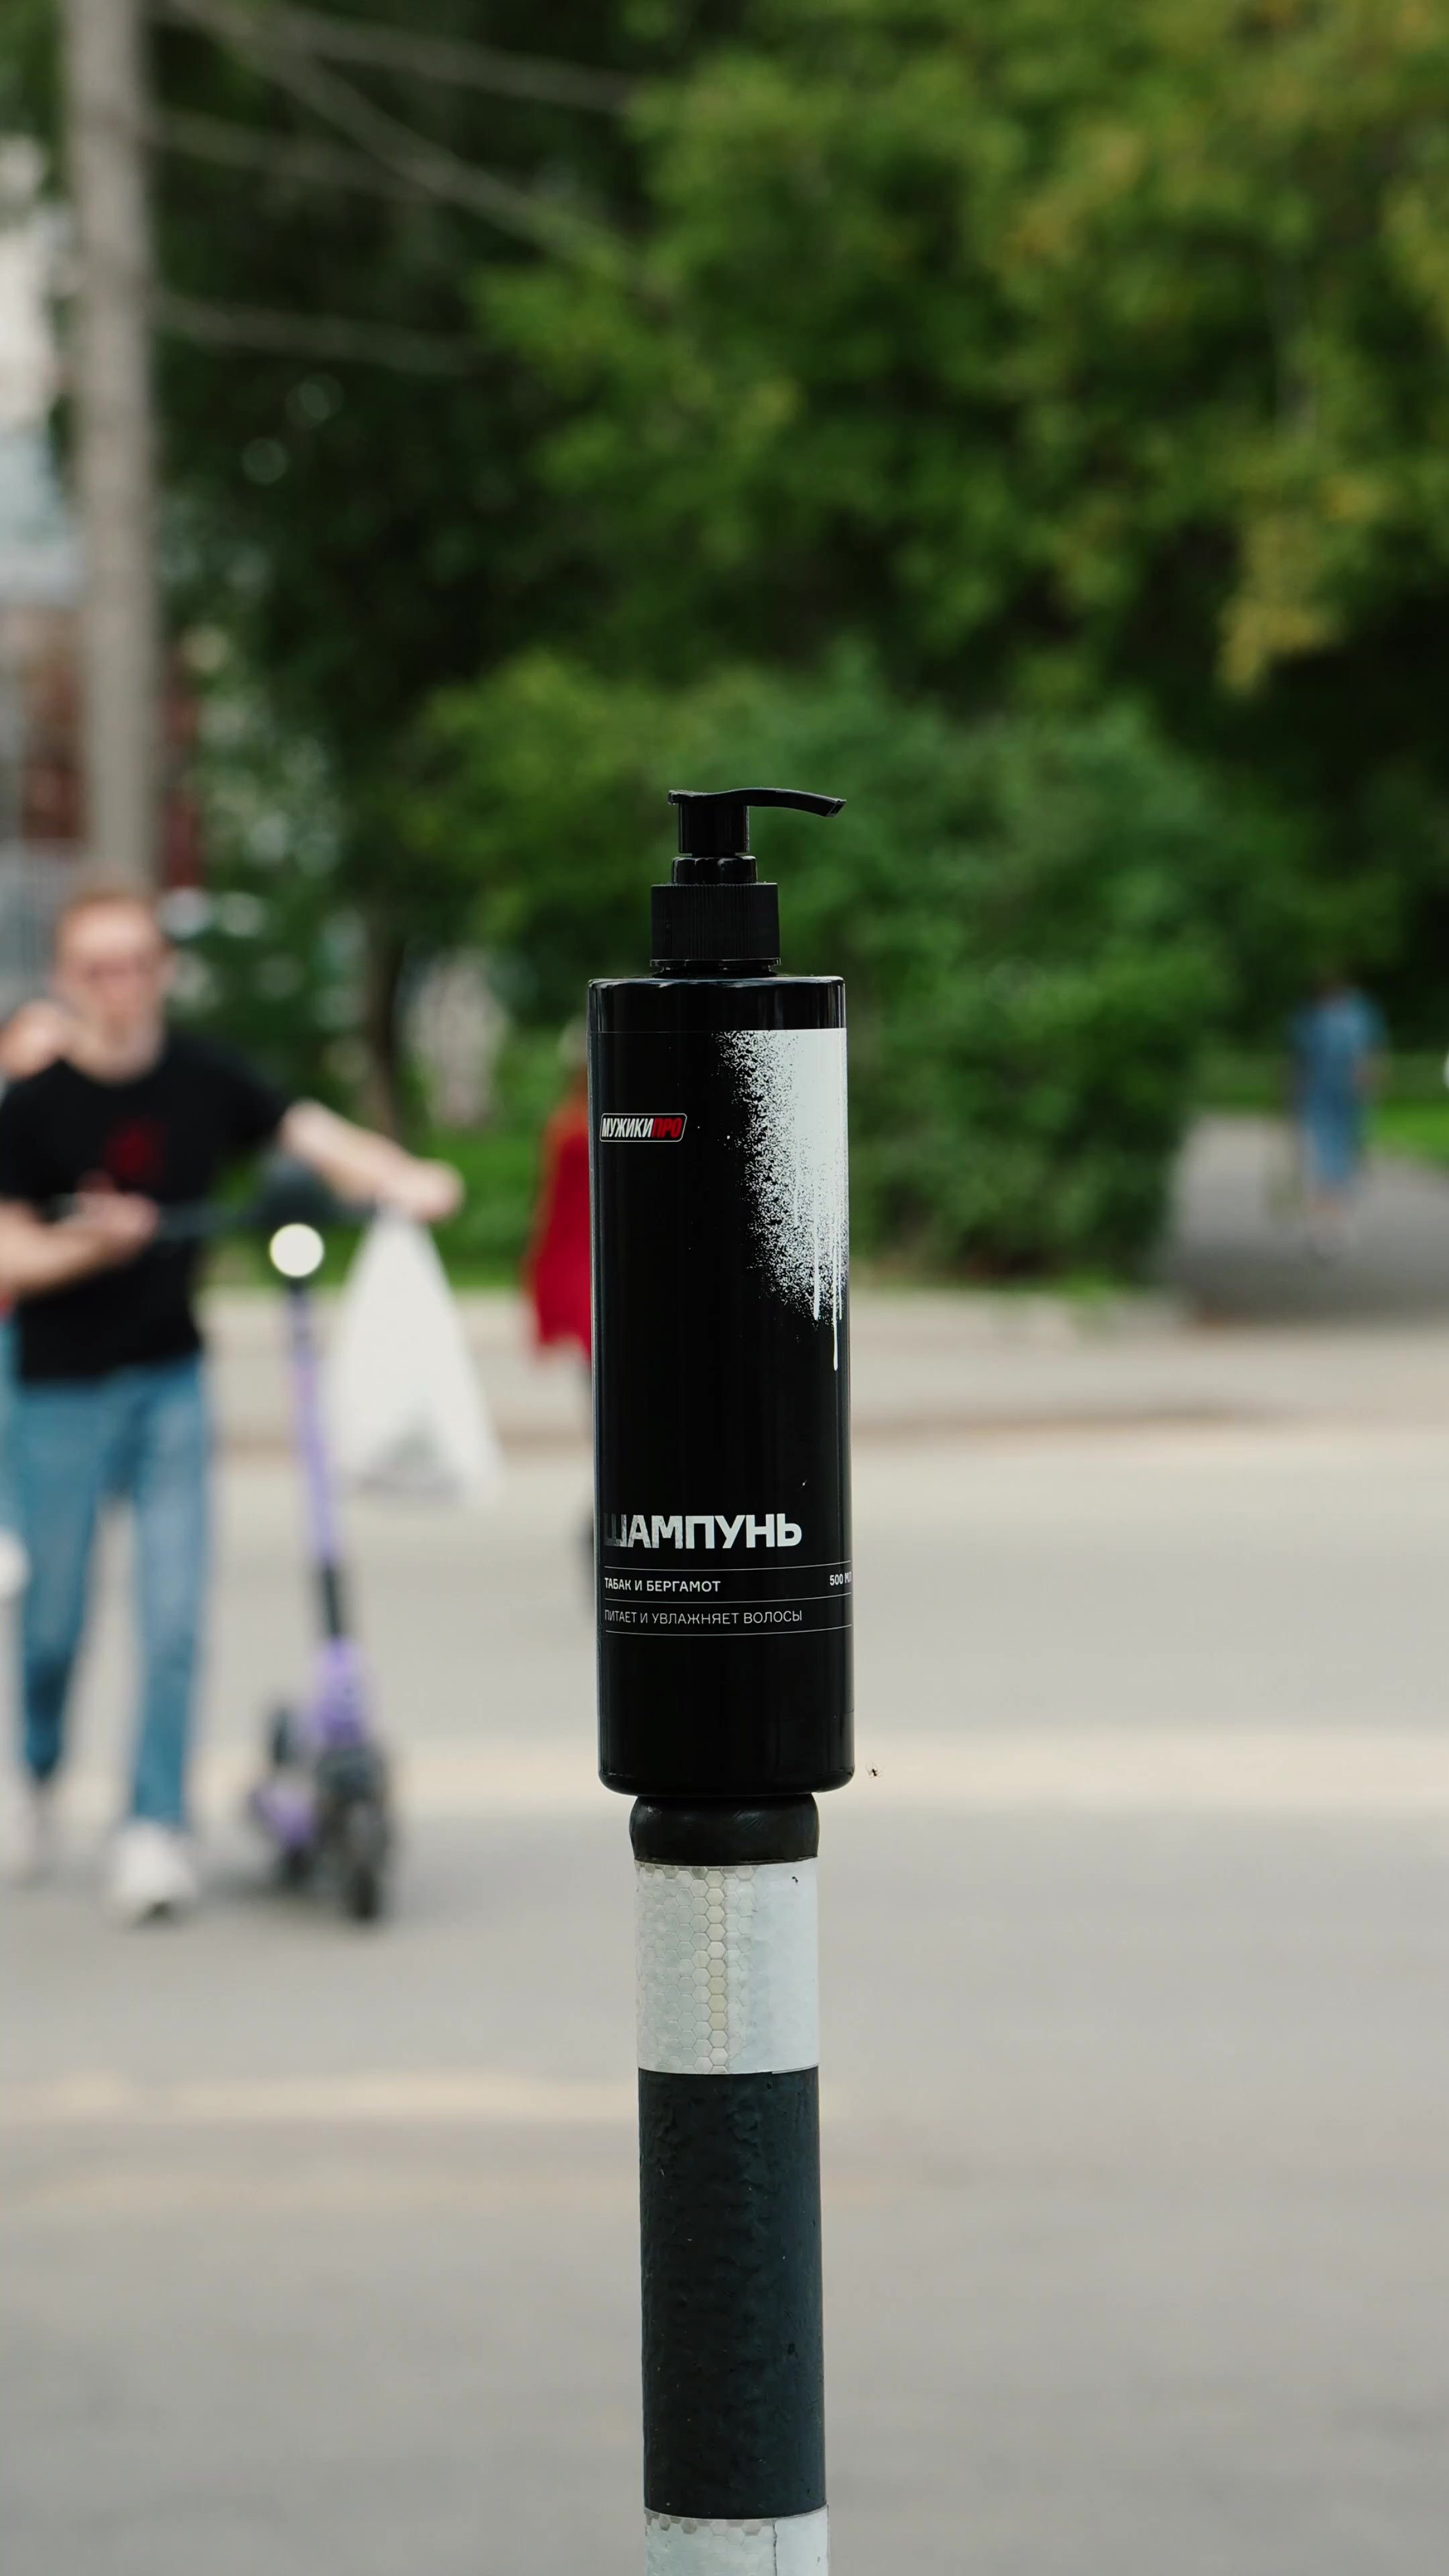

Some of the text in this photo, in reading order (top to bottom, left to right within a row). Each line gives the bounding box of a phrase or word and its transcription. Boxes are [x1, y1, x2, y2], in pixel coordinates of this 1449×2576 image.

[604, 1513, 802, 1550] ШАМПУНЬ
[604, 1577, 721, 1593] ТАБАК И БЕРГАМОТ
[829, 1573, 844, 1587] 500
[605, 1609, 802, 1624] ПИТАЕТ И УВЛАЖНЯЕТ ВОЛОСЫ
